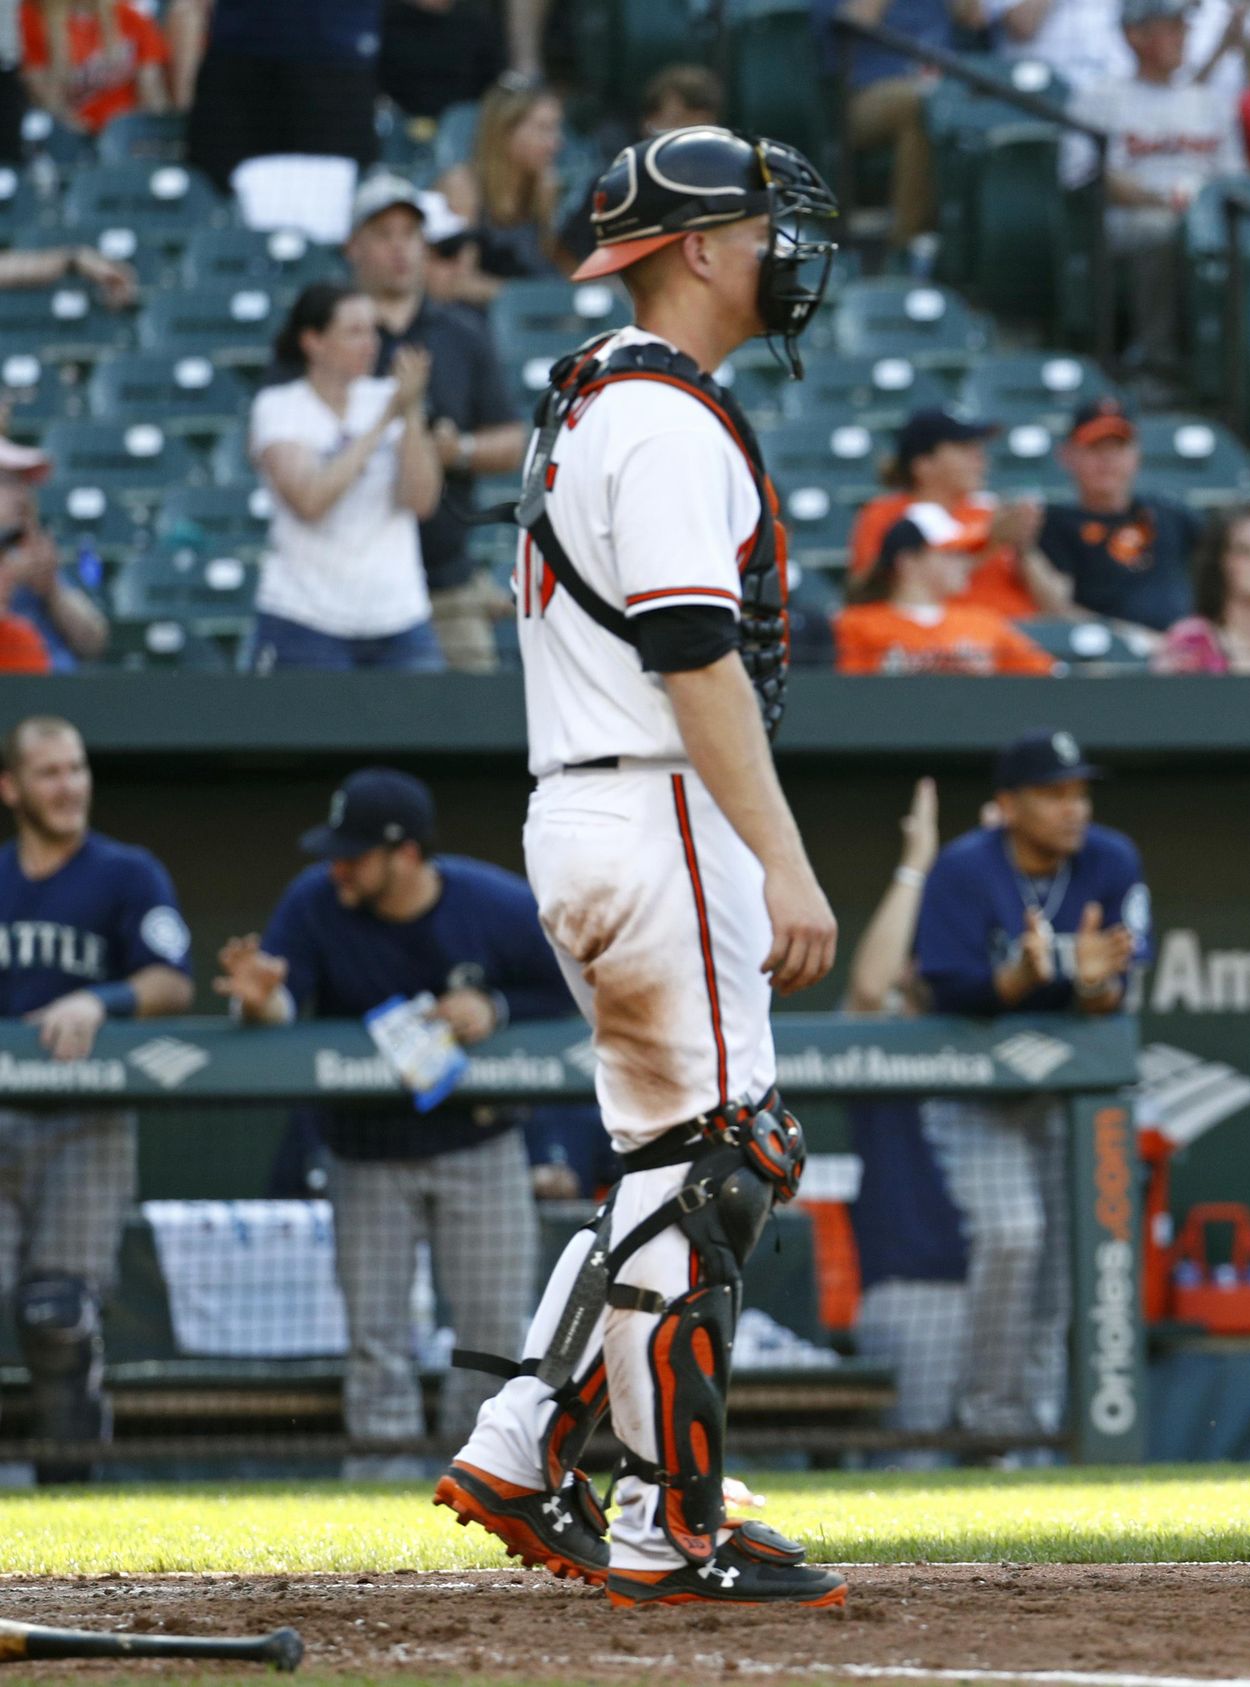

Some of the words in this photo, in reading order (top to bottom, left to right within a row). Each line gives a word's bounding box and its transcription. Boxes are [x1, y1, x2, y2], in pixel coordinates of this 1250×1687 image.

[460, 1050, 566, 1089] merica
[776, 1046, 823, 1086] ank
[827, 1046, 863, 1086] of
[866, 1046, 995, 1086] America
[1091, 1107, 1137, 1435] Orioles.com
